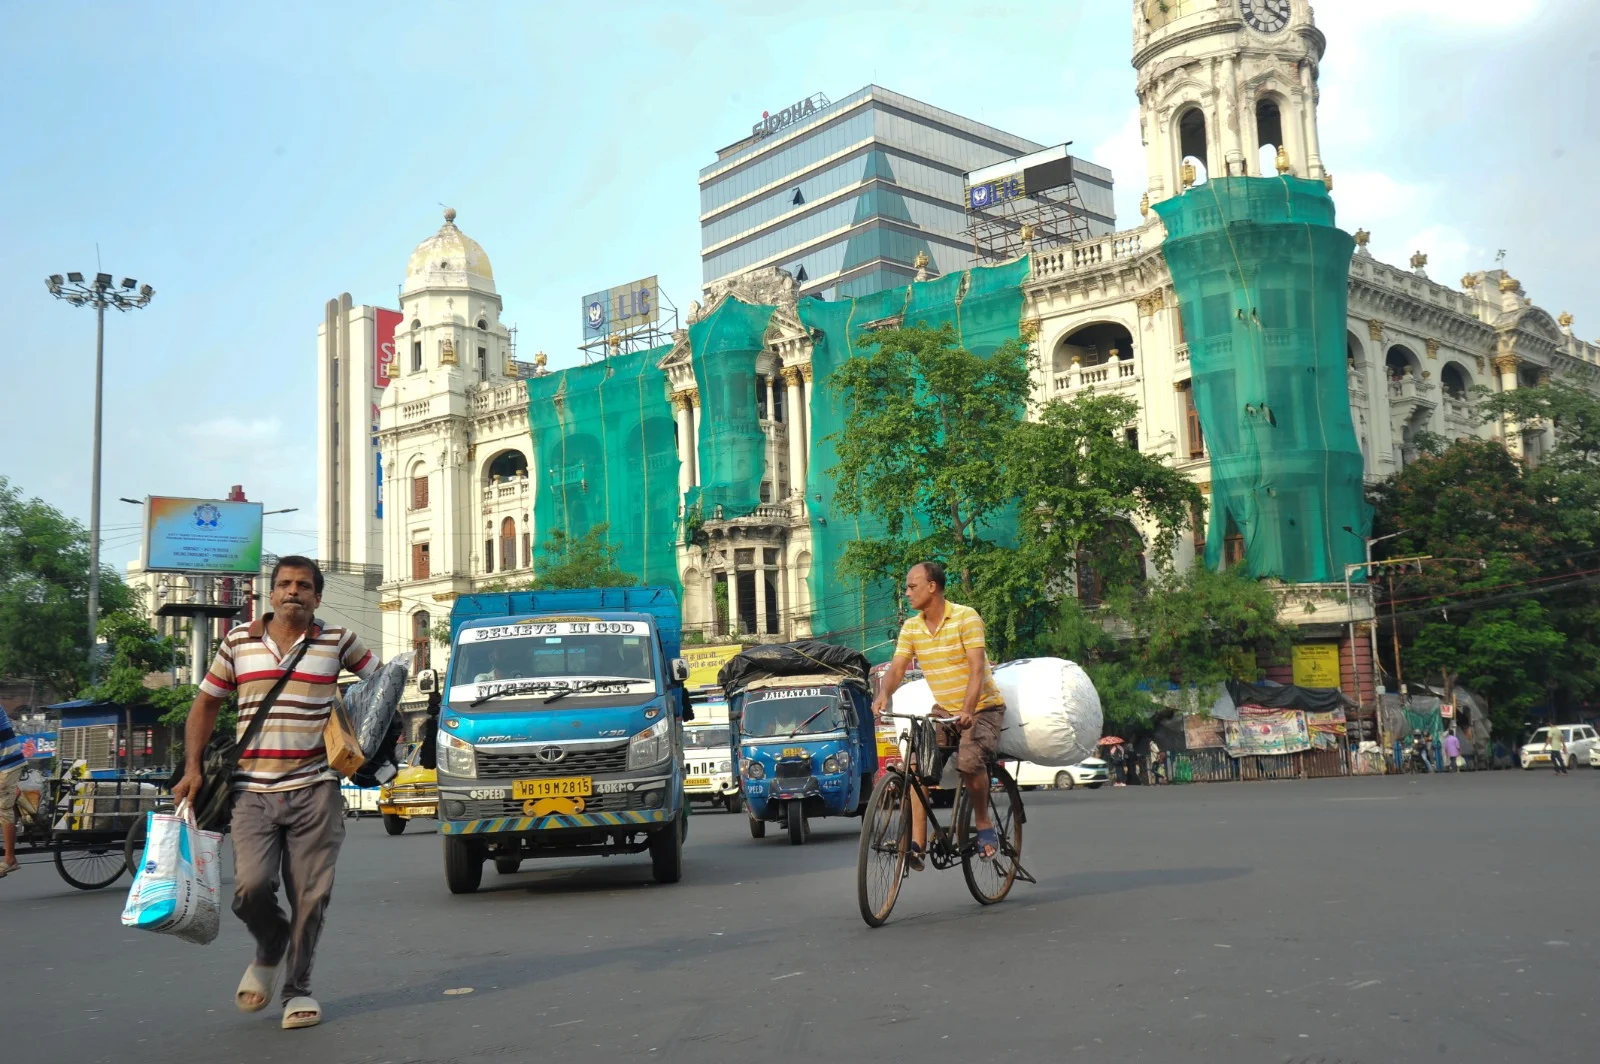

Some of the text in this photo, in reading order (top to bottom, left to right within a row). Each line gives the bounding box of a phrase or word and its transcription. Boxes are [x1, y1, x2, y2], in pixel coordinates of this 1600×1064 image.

[993, 179, 1020, 203] LIC
[618, 287, 650, 321] LIC
[475, 622, 635, 641] BELIEVE IN GOD
[763, 688, 821, 700] JAIMATA DI
[477, 734, 512, 743] INTRA
[477, 789, 506, 800] SPEED
[522, 780, 590, 796] WB 19 M 2815
